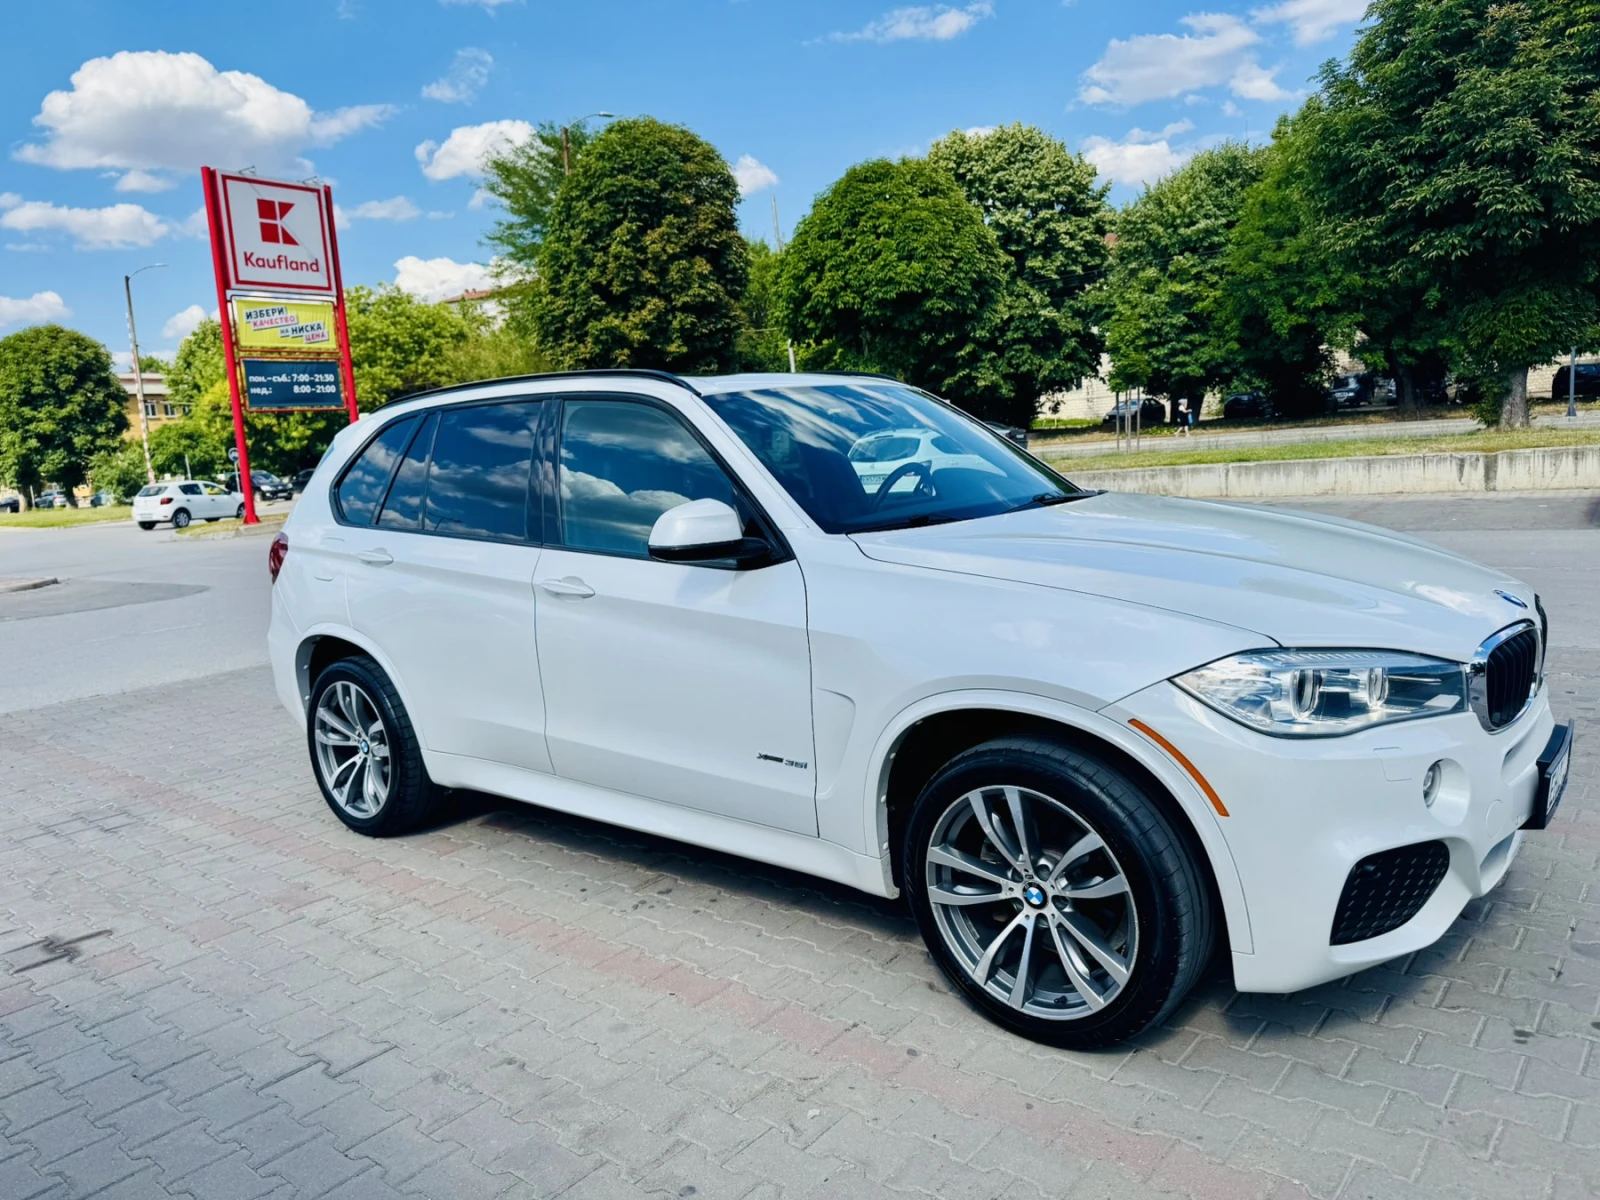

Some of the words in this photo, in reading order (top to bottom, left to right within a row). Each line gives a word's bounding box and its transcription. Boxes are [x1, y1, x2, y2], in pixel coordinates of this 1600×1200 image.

[243, 251, 320, 273] Kaufland
[245, 307, 285, 320] ИЗБЕРИ
[253, 315, 296, 328] КАЧЕСТВО
[291, 323, 322, 335] НИСКА
[305, 332, 326, 342] ЦЕНА
